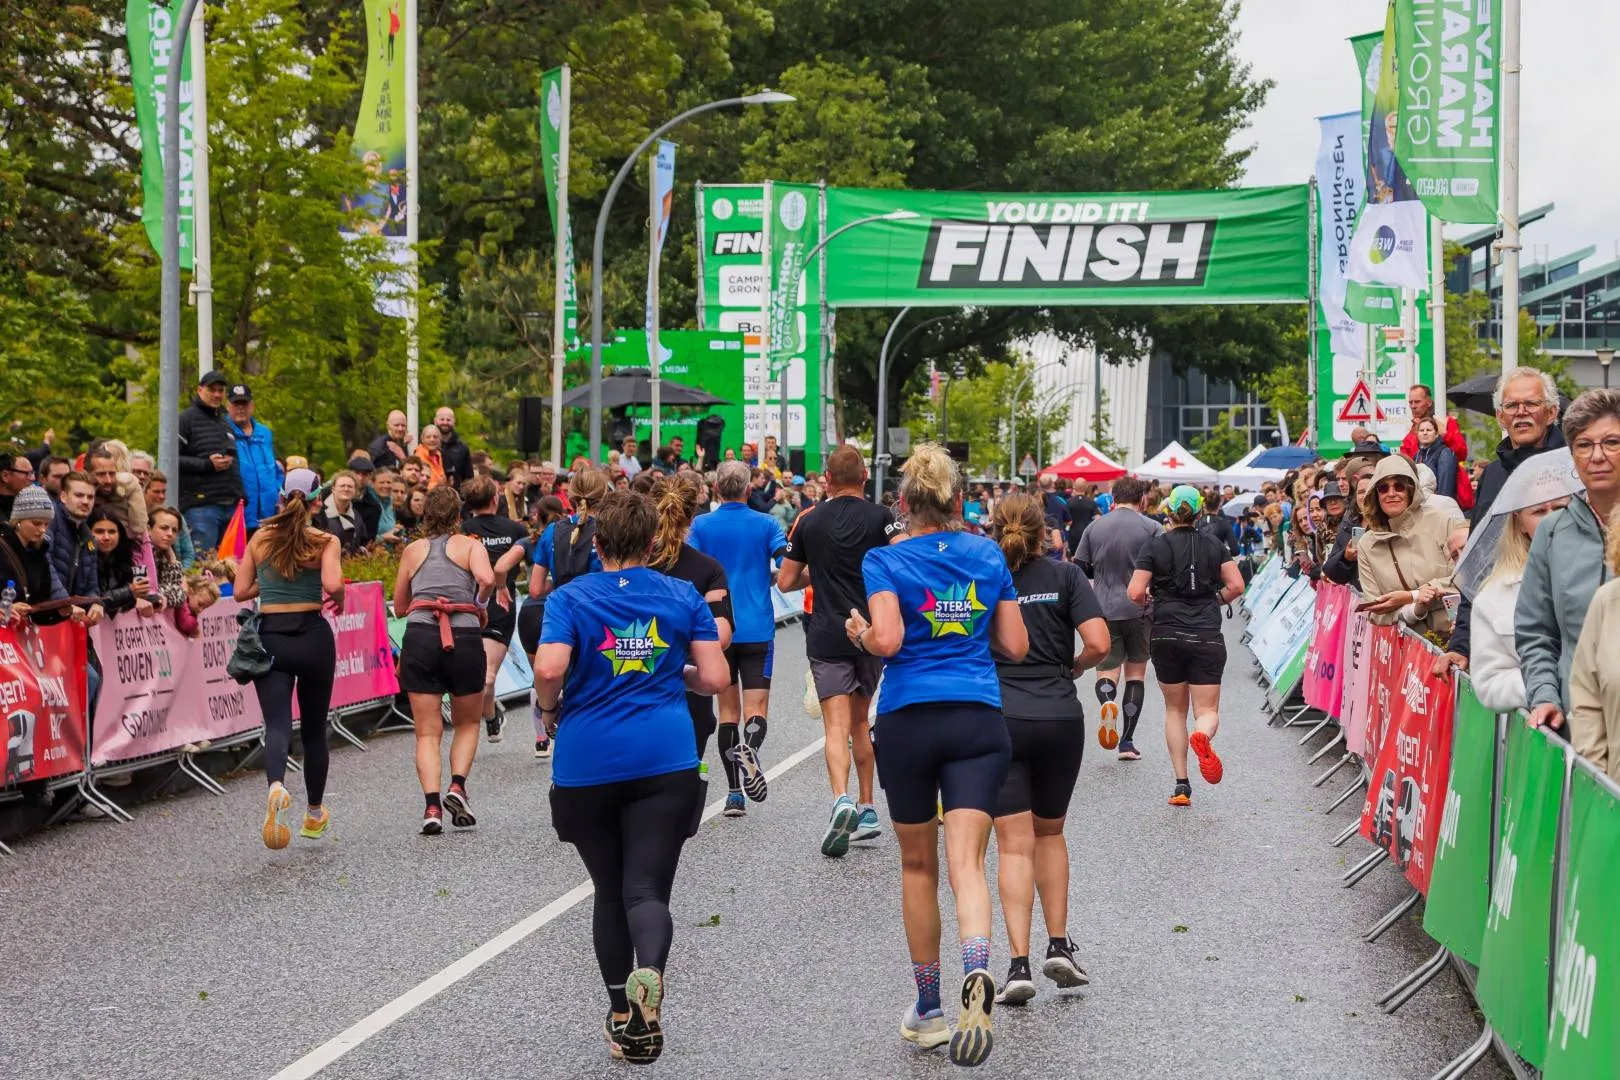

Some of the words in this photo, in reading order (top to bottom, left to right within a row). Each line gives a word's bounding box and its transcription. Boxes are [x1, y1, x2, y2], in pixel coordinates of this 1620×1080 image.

[986, 202, 1049, 223] YOU
[1051, 203, 1102, 222] DID
[1107, 202, 1149, 222] IT!
[715, 232, 763, 254] FIN
[929, 223, 1206, 282] FINISH
[728, 275, 764, 284] CAMP
[776, 242, 795, 350] MARATHON
[482, 536, 512, 546] Hanze
[935, 600, 972, 611] STERK
[935, 611, 971, 620] Hoogkerk
[615, 638, 653, 649] STERK
[615, 648, 653, 656] Hoogkerk
[117, 651, 154, 685] BOVEN
